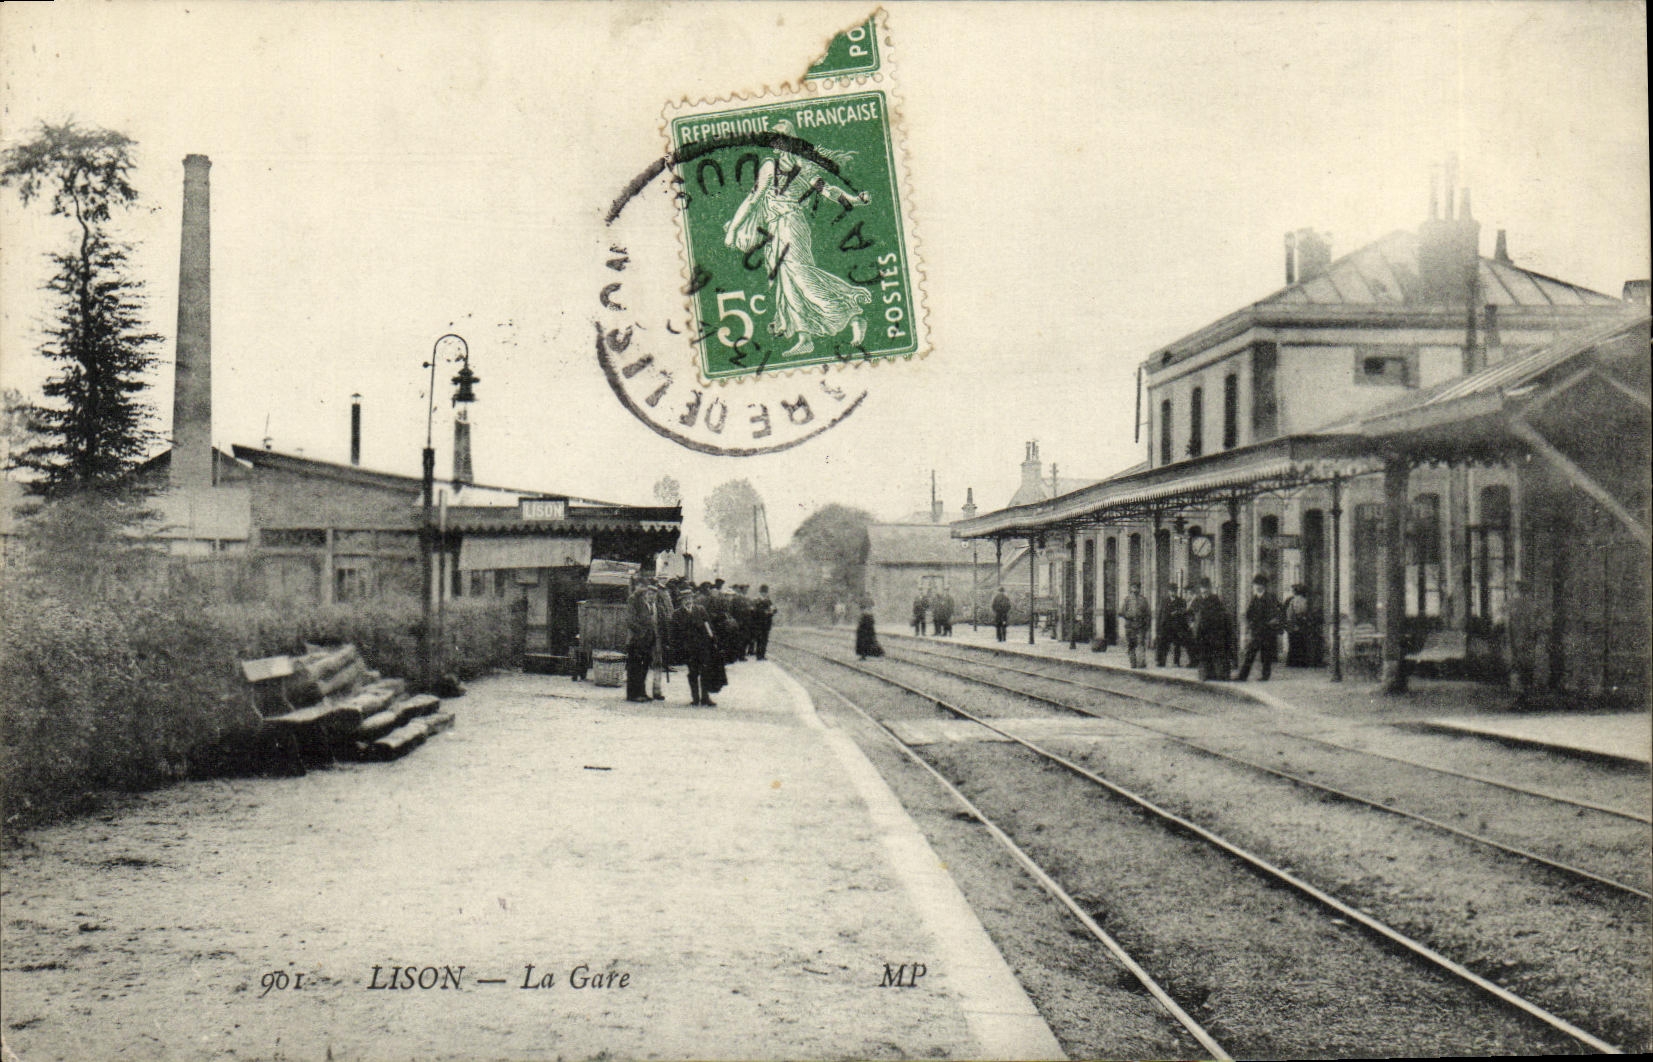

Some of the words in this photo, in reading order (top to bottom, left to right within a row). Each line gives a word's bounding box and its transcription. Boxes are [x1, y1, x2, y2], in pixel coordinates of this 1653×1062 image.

[796, 102, 879, 128] FRANÇAISE
[878, 252, 906, 339] POSTES
[525, 503, 562, 518] LISON
